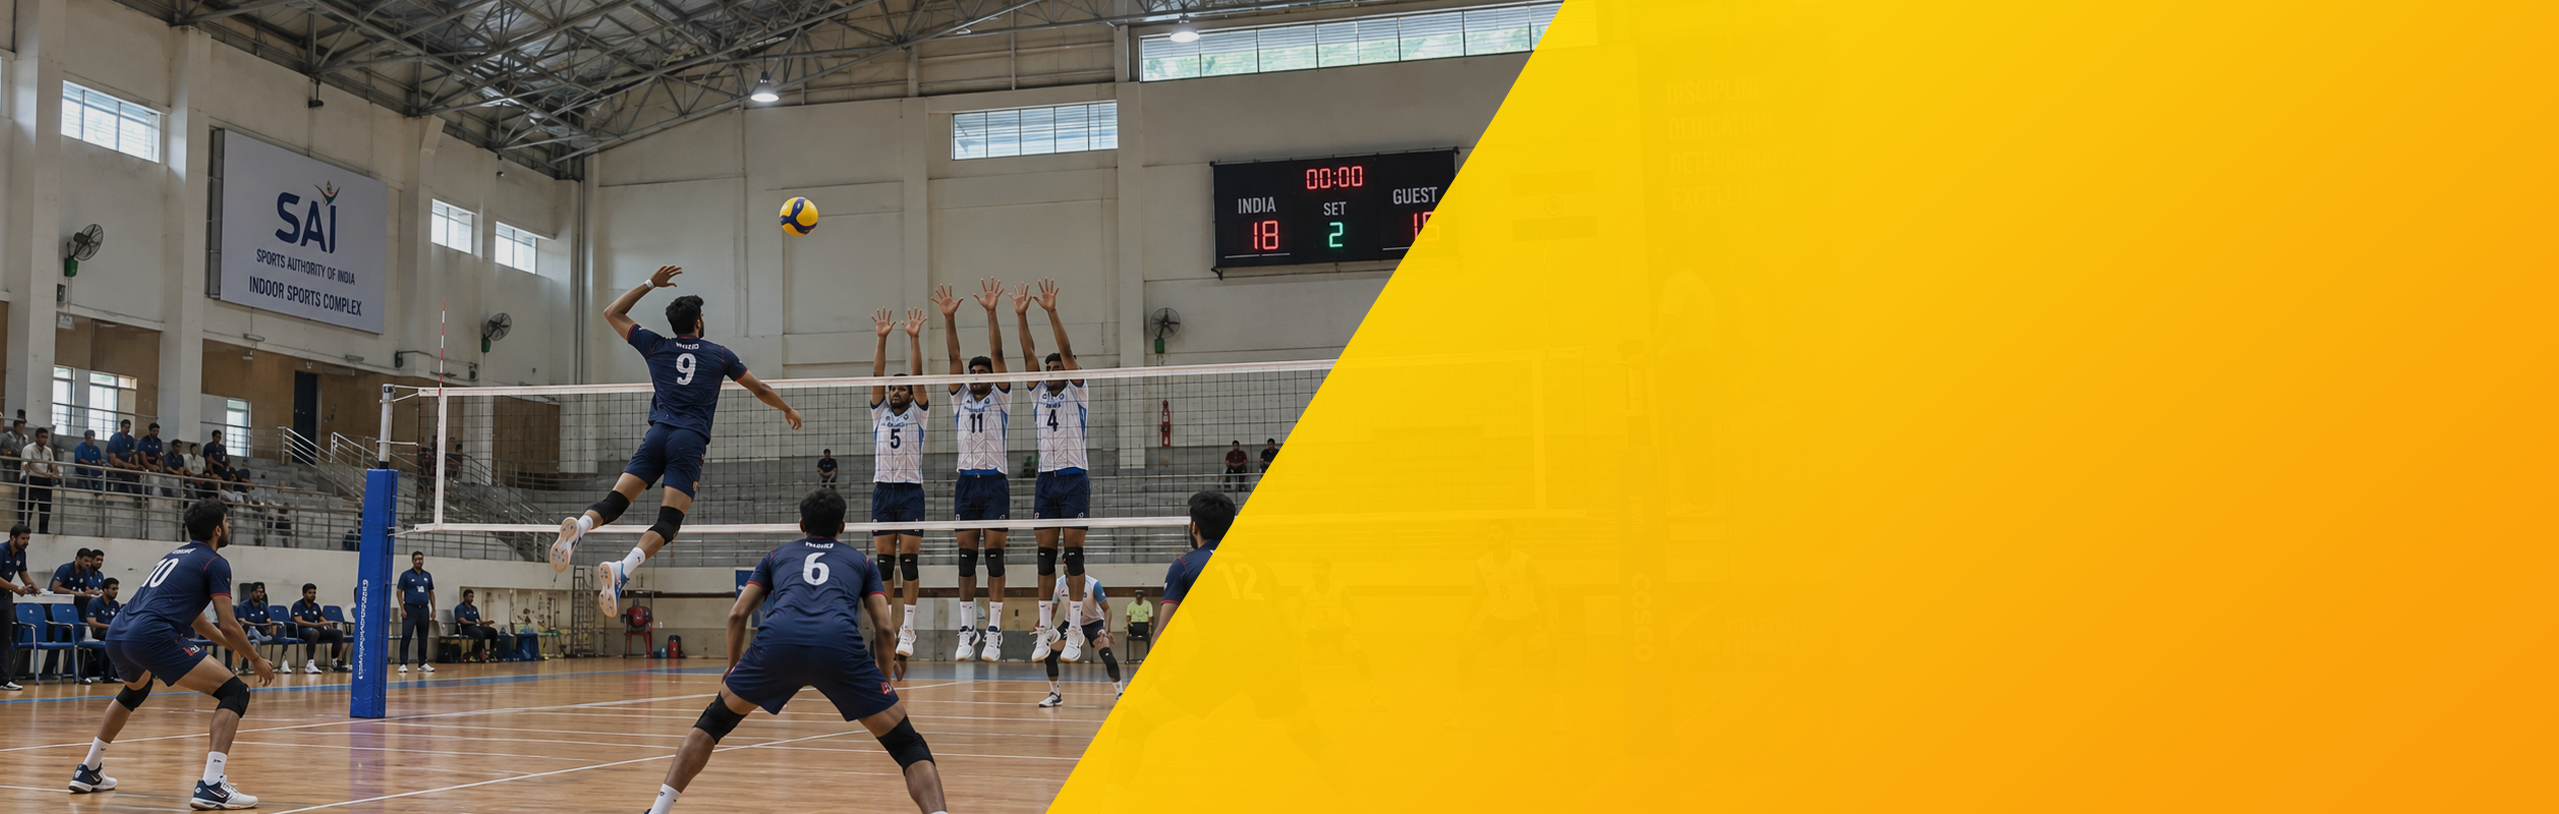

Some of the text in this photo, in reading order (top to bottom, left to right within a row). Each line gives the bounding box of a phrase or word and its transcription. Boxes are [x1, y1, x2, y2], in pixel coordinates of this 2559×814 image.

[1306, 165, 1363, 190] 00:00
[1238, 196, 1276, 214] INDIA
[1323, 201, 1347, 216] SET
[1392, 187, 1438, 205] GUEST
[275, 192, 337, 254] SAI
[1253, 220, 1279, 250] 18
[1329, 221, 1344, 248] 2
[256, 248, 356, 286] SPORTS AUTHORITY OF INDIA
[249, 275, 362, 317] INDOOR SPORTS COMPLEX
[676, 353, 697, 386] 9
[969, 412, 984, 434] 11
[1047, 408, 1059, 432] 4
[889, 428, 901, 449] 5
[141, 557, 179, 588] 10
[802, 552, 830, 586] 6
[1214, 561, 1265, 602] 12
